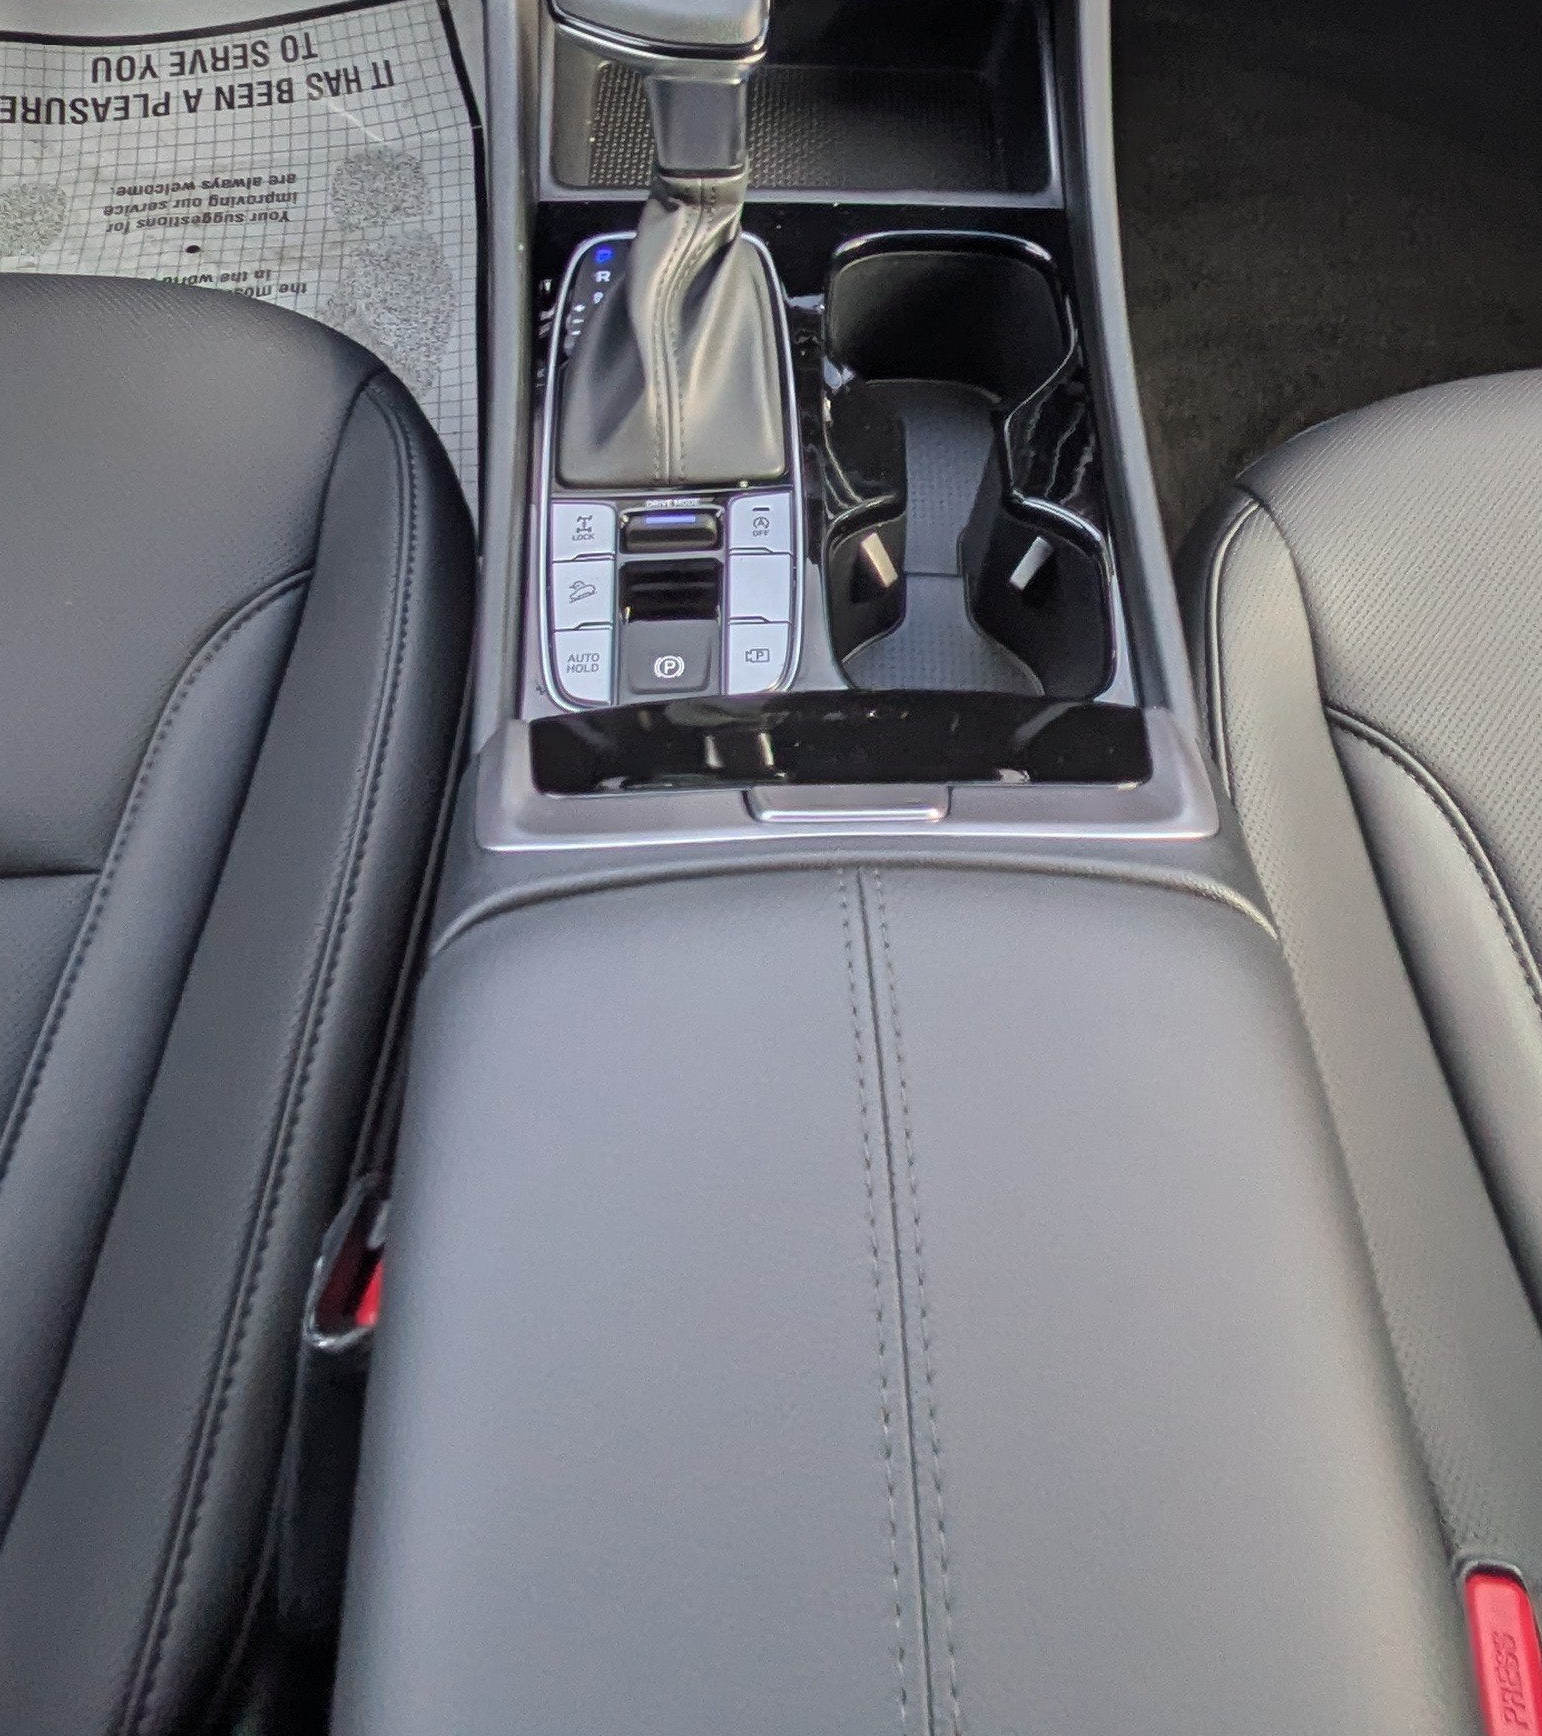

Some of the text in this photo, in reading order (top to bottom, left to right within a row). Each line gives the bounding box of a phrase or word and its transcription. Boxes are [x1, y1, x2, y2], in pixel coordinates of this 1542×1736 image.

[91, 32, 319, 84] TO SERVE YOU
[370, 58, 395, 91] IT
[305, 66, 361, 102] HAS
[182, 88, 204, 114] A
[214, 77, 295, 112] BEEN
[200, 176, 263, 191] always
[268, 172, 297, 185] are
[103, 191, 298, 217] improving our service
[105, 210, 291, 236] Your suggestions for
[219, 269, 249, 283] the
[254, 269, 272, 281] in
[595, 270, 611, 283] R
[277, 281, 308, 295] the
[571, 532, 595, 542] LOCK
[752, 528, 770, 538] OFF
[566, 652, 600, 664] AUTO
[565, 663, 600, 674] HOLD
